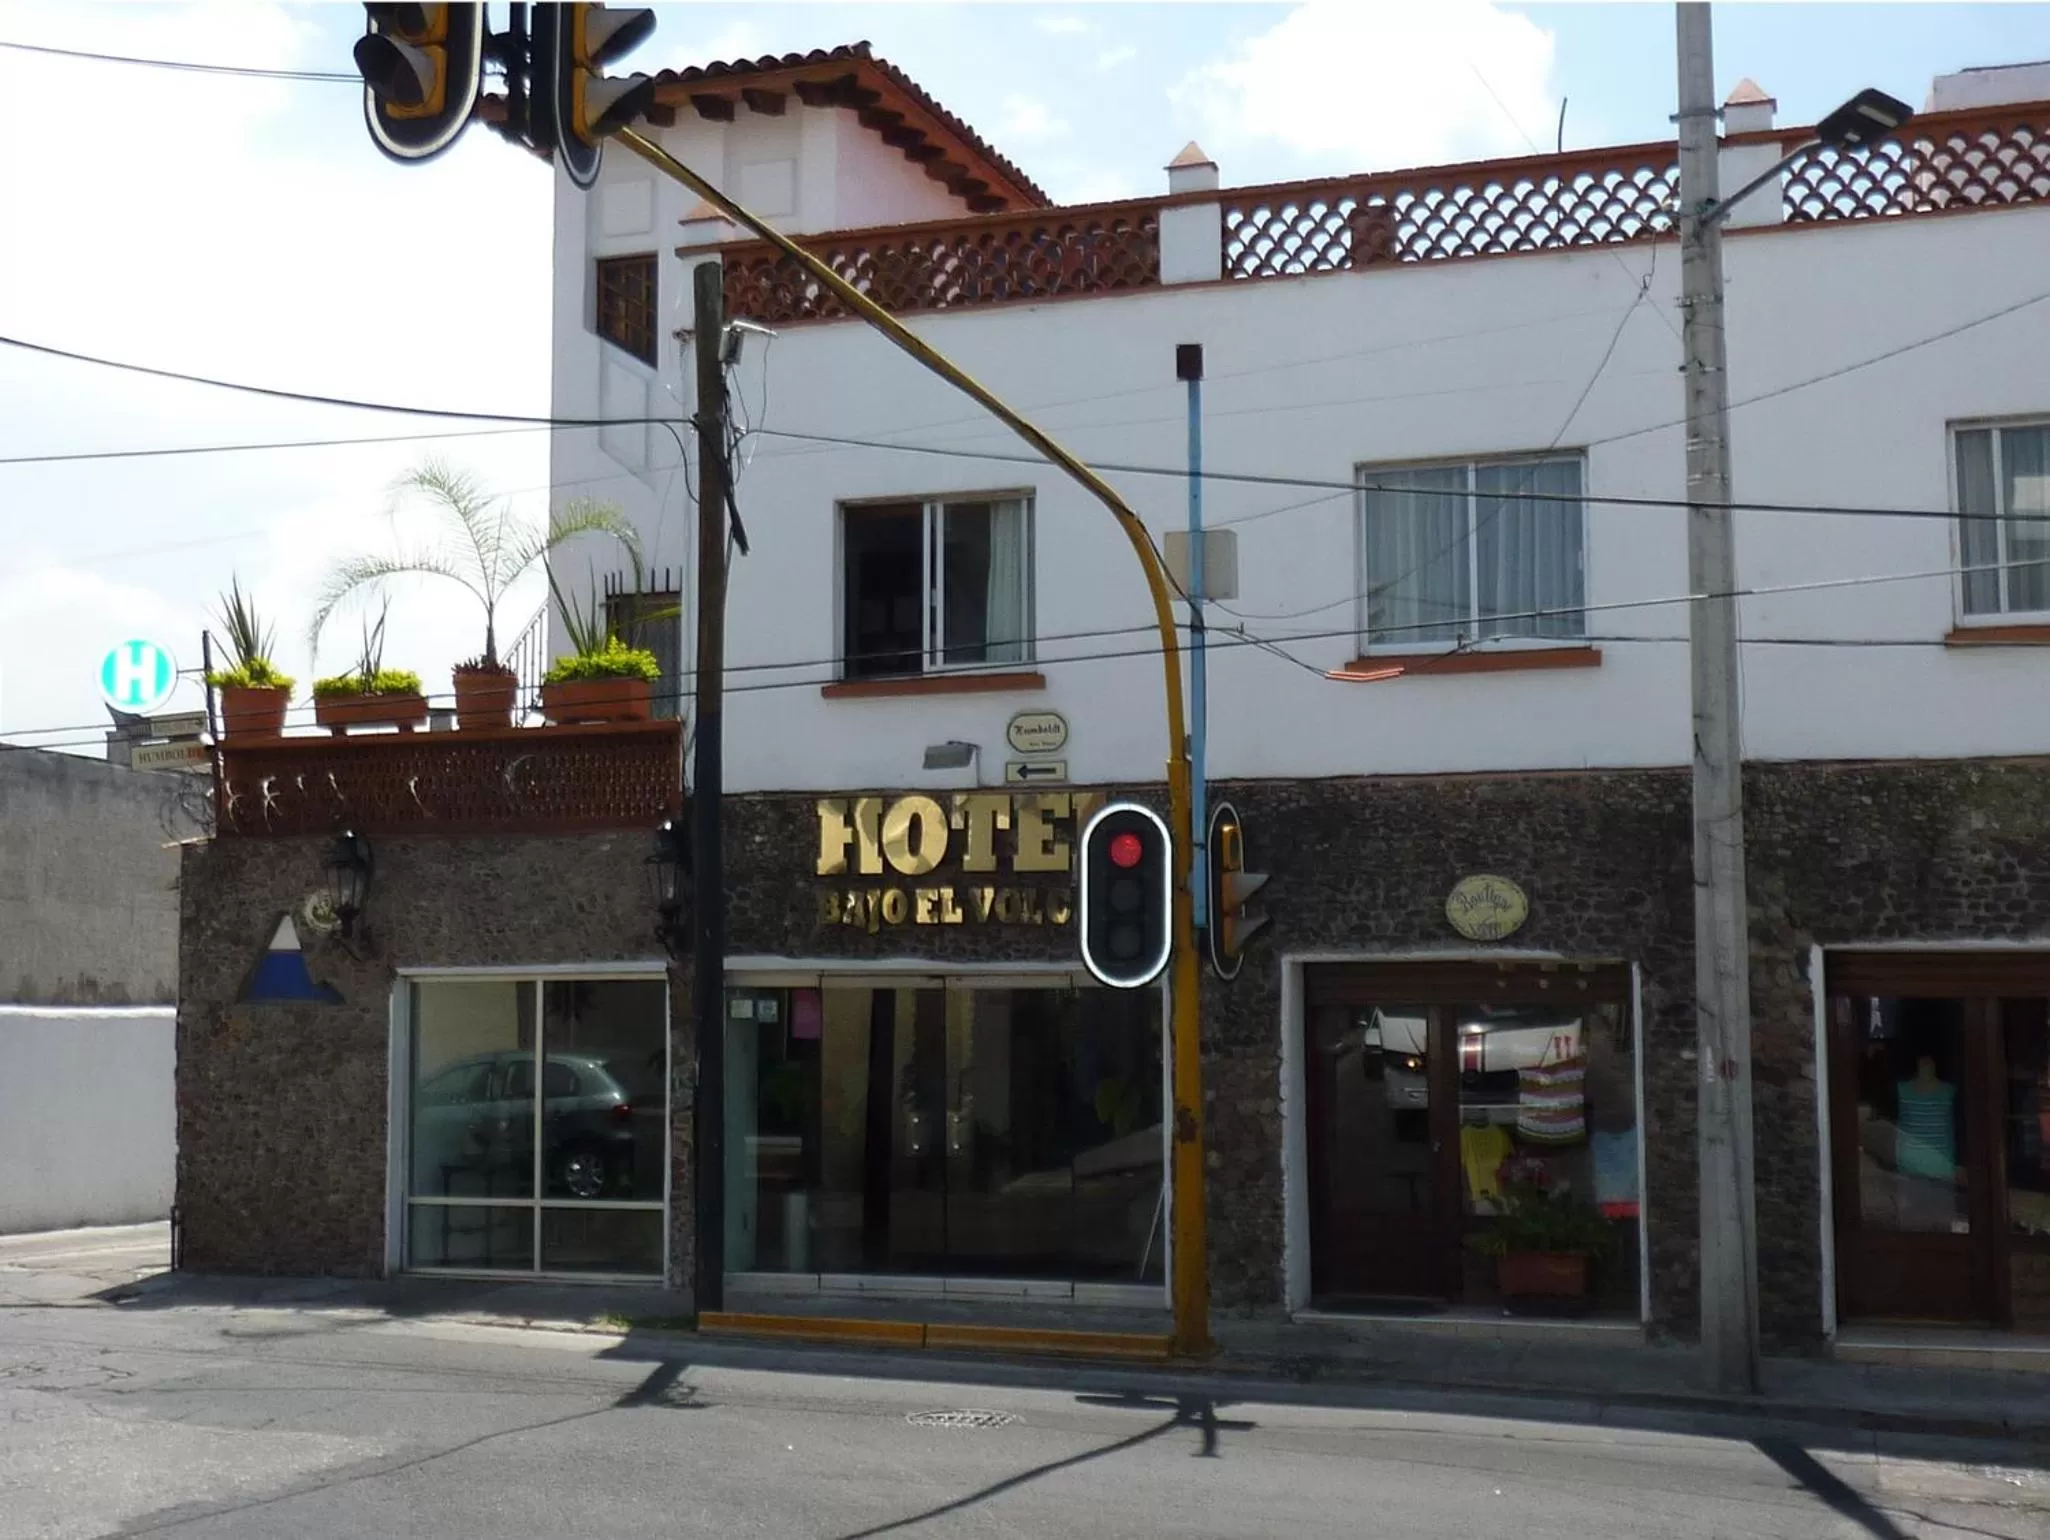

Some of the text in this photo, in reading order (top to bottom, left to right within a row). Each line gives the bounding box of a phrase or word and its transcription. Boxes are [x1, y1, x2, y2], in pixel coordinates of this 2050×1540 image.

[115, 645, 157, 702] H
[821, 887, 908, 934] BAJO
[914, 886, 963, 925] EL
